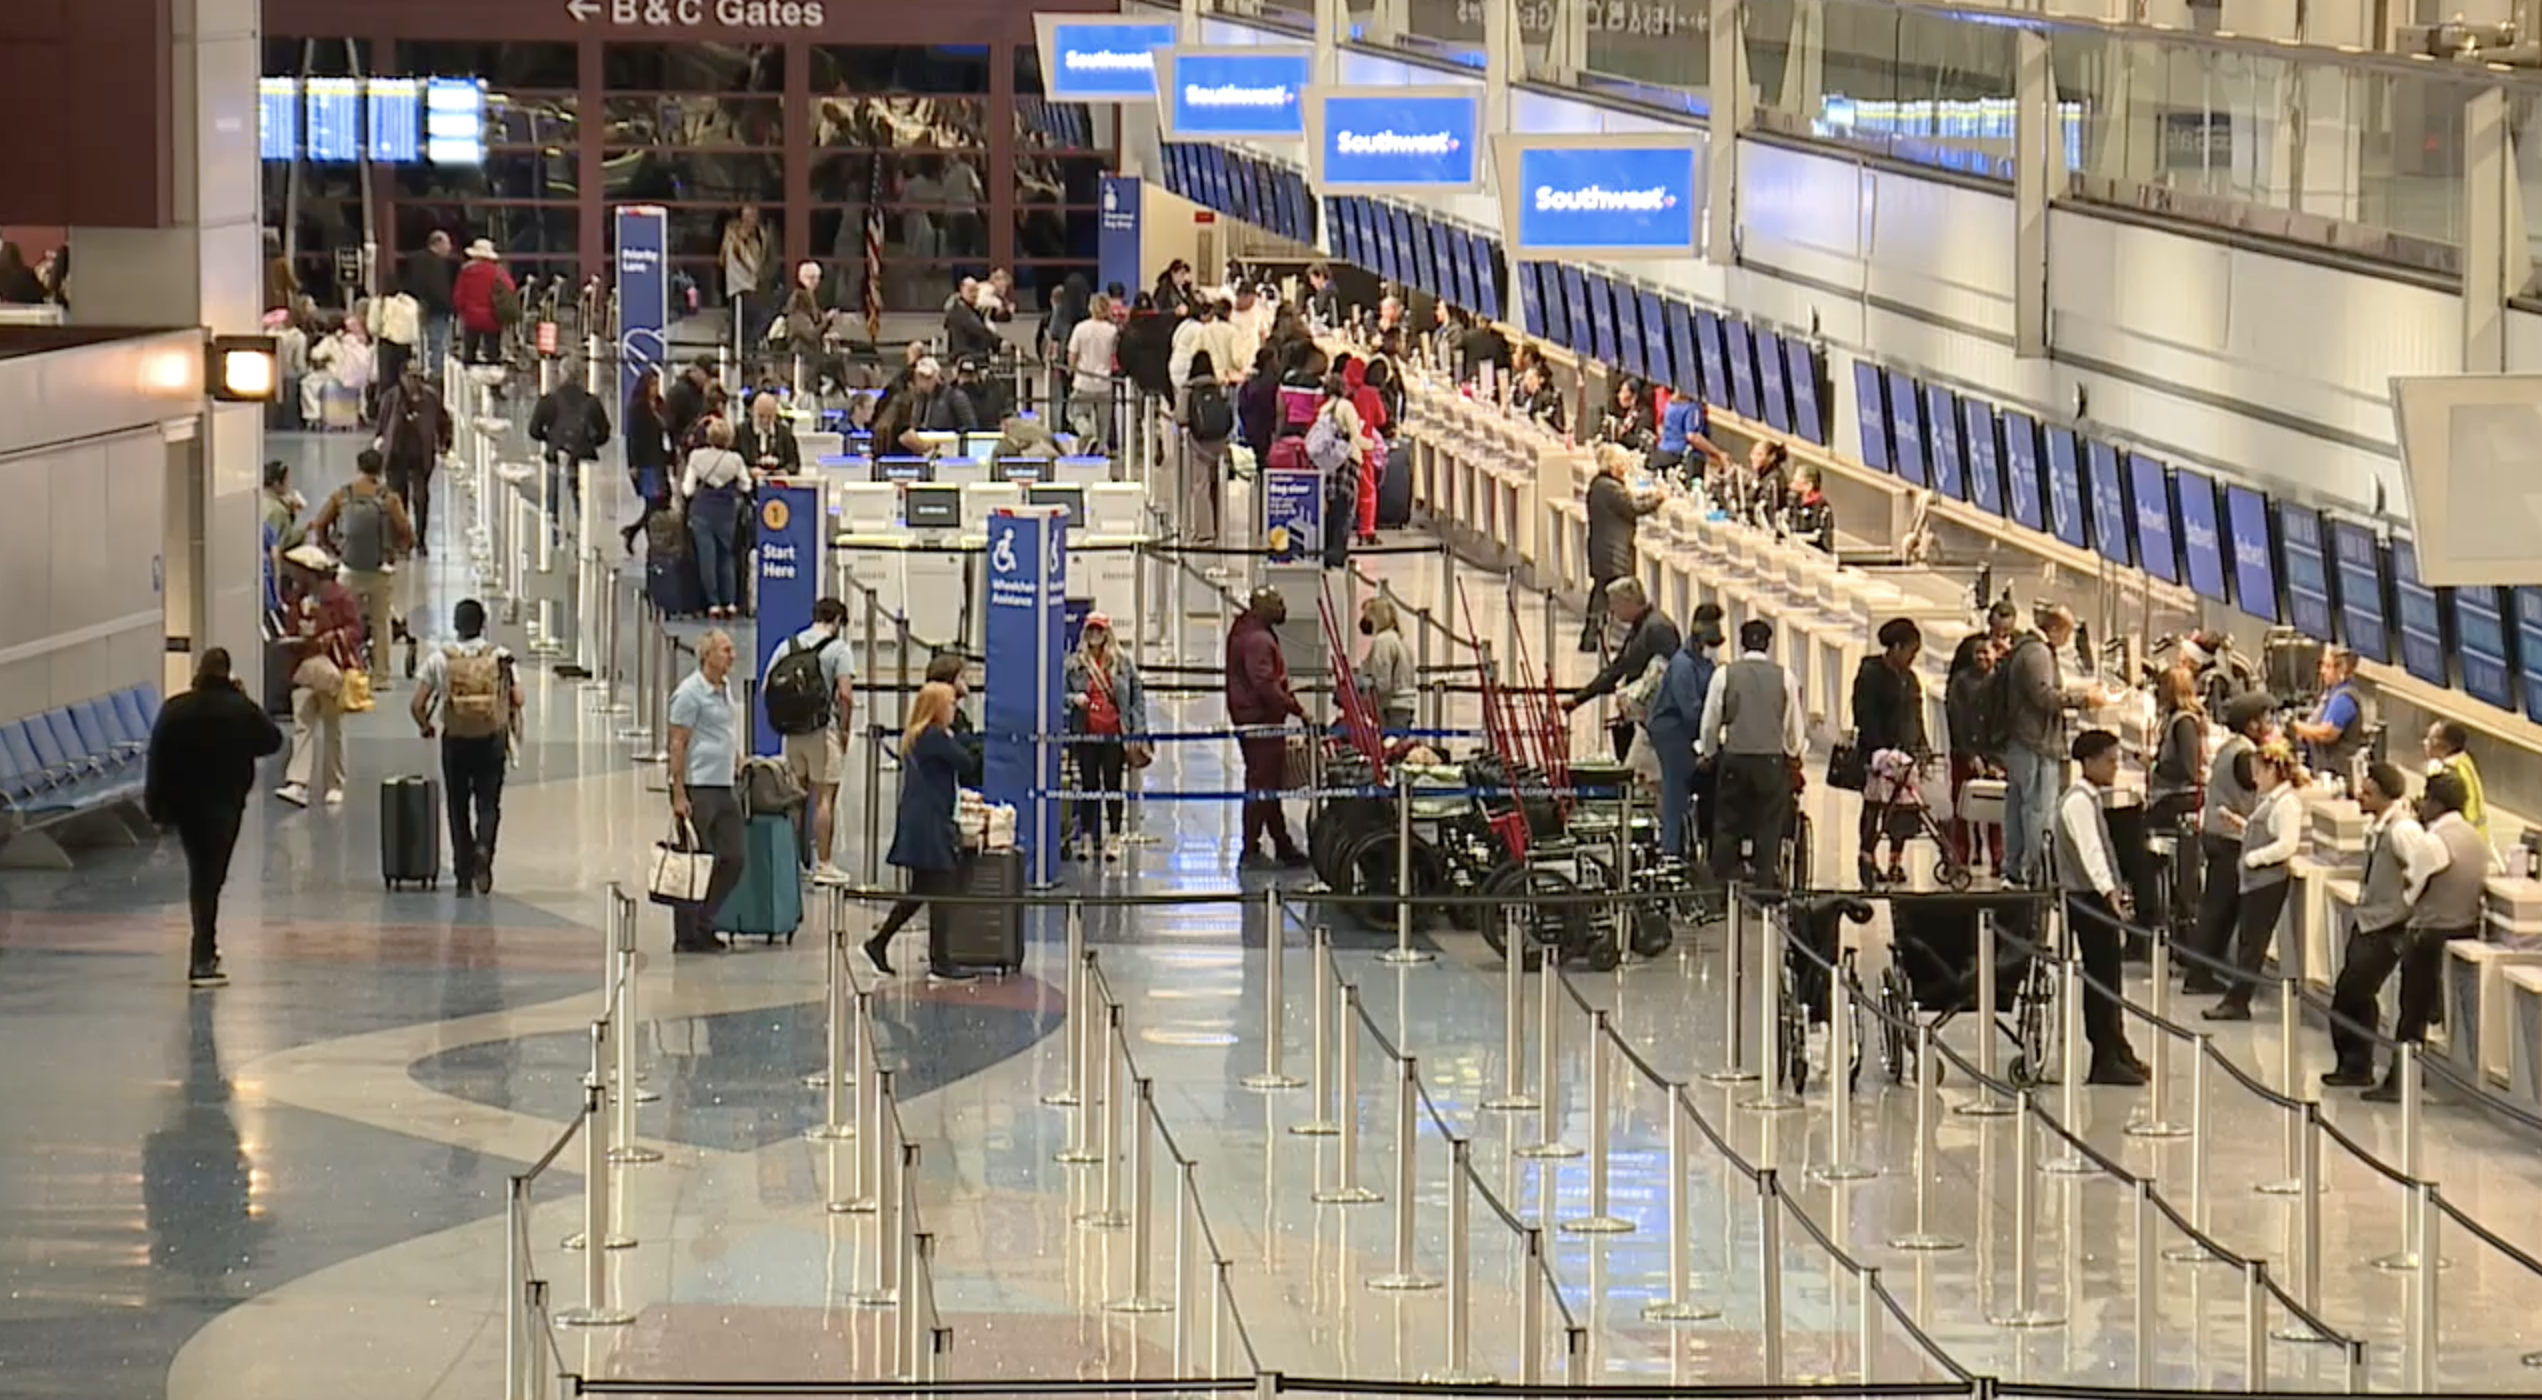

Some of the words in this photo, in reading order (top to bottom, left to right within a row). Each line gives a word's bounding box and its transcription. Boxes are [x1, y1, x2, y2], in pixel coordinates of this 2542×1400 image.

[717, 0, 824, 26] Gates
[1185, 83, 1285, 105] Southwest
[1337, 130, 1450, 153] Southwest
[1535, 186, 1666, 210] Southwest
[763, 544, 795, 559] Start
[763, 562, 795, 578] Here
[993, 580, 1036, 592] Wheelchair
[993, 593, 1033, 606] Assistance
